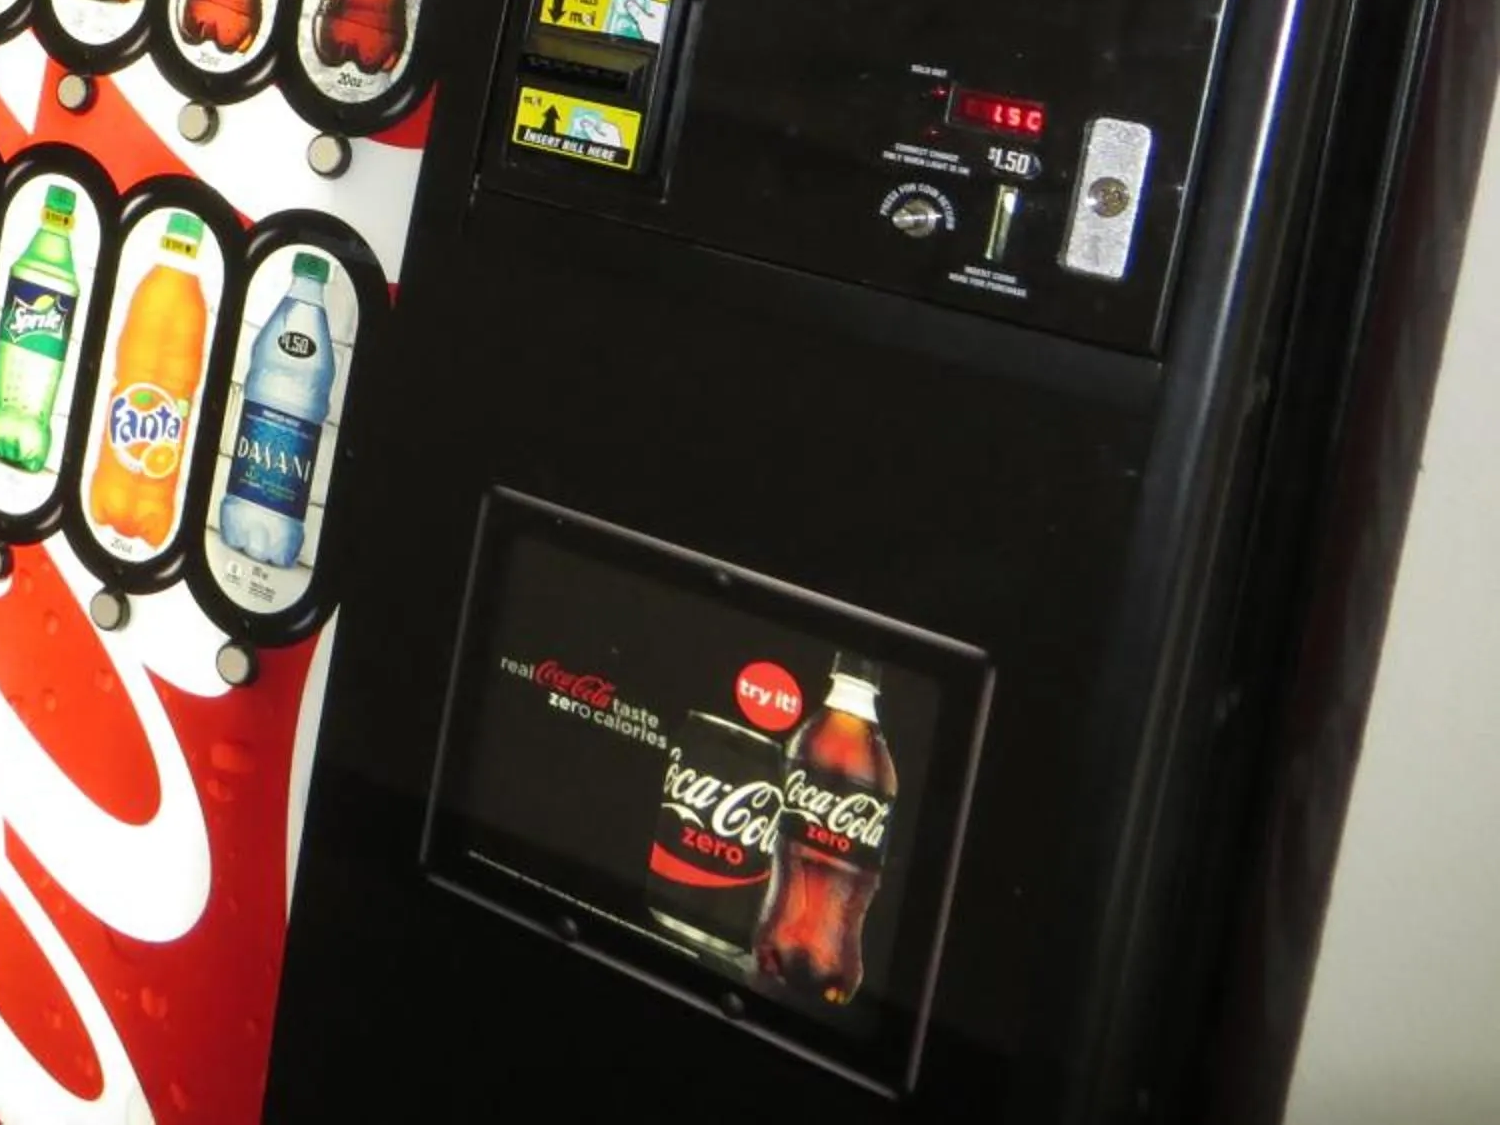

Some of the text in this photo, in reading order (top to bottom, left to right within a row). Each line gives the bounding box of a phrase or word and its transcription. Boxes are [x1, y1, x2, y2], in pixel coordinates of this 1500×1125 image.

[523, 128, 562, 148] INSERT
[10, 306, 62, 334] Sprite
[238, 436, 311, 483] DASANI
[500, 656, 534, 680] real
[613, 697, 660, 729] taste
[738, 678, 799, 715] try it!
[548, 691, 668, 751] zero calories
[681, 826, 744, 866] zero
[806, 825, 851, 853] zero
